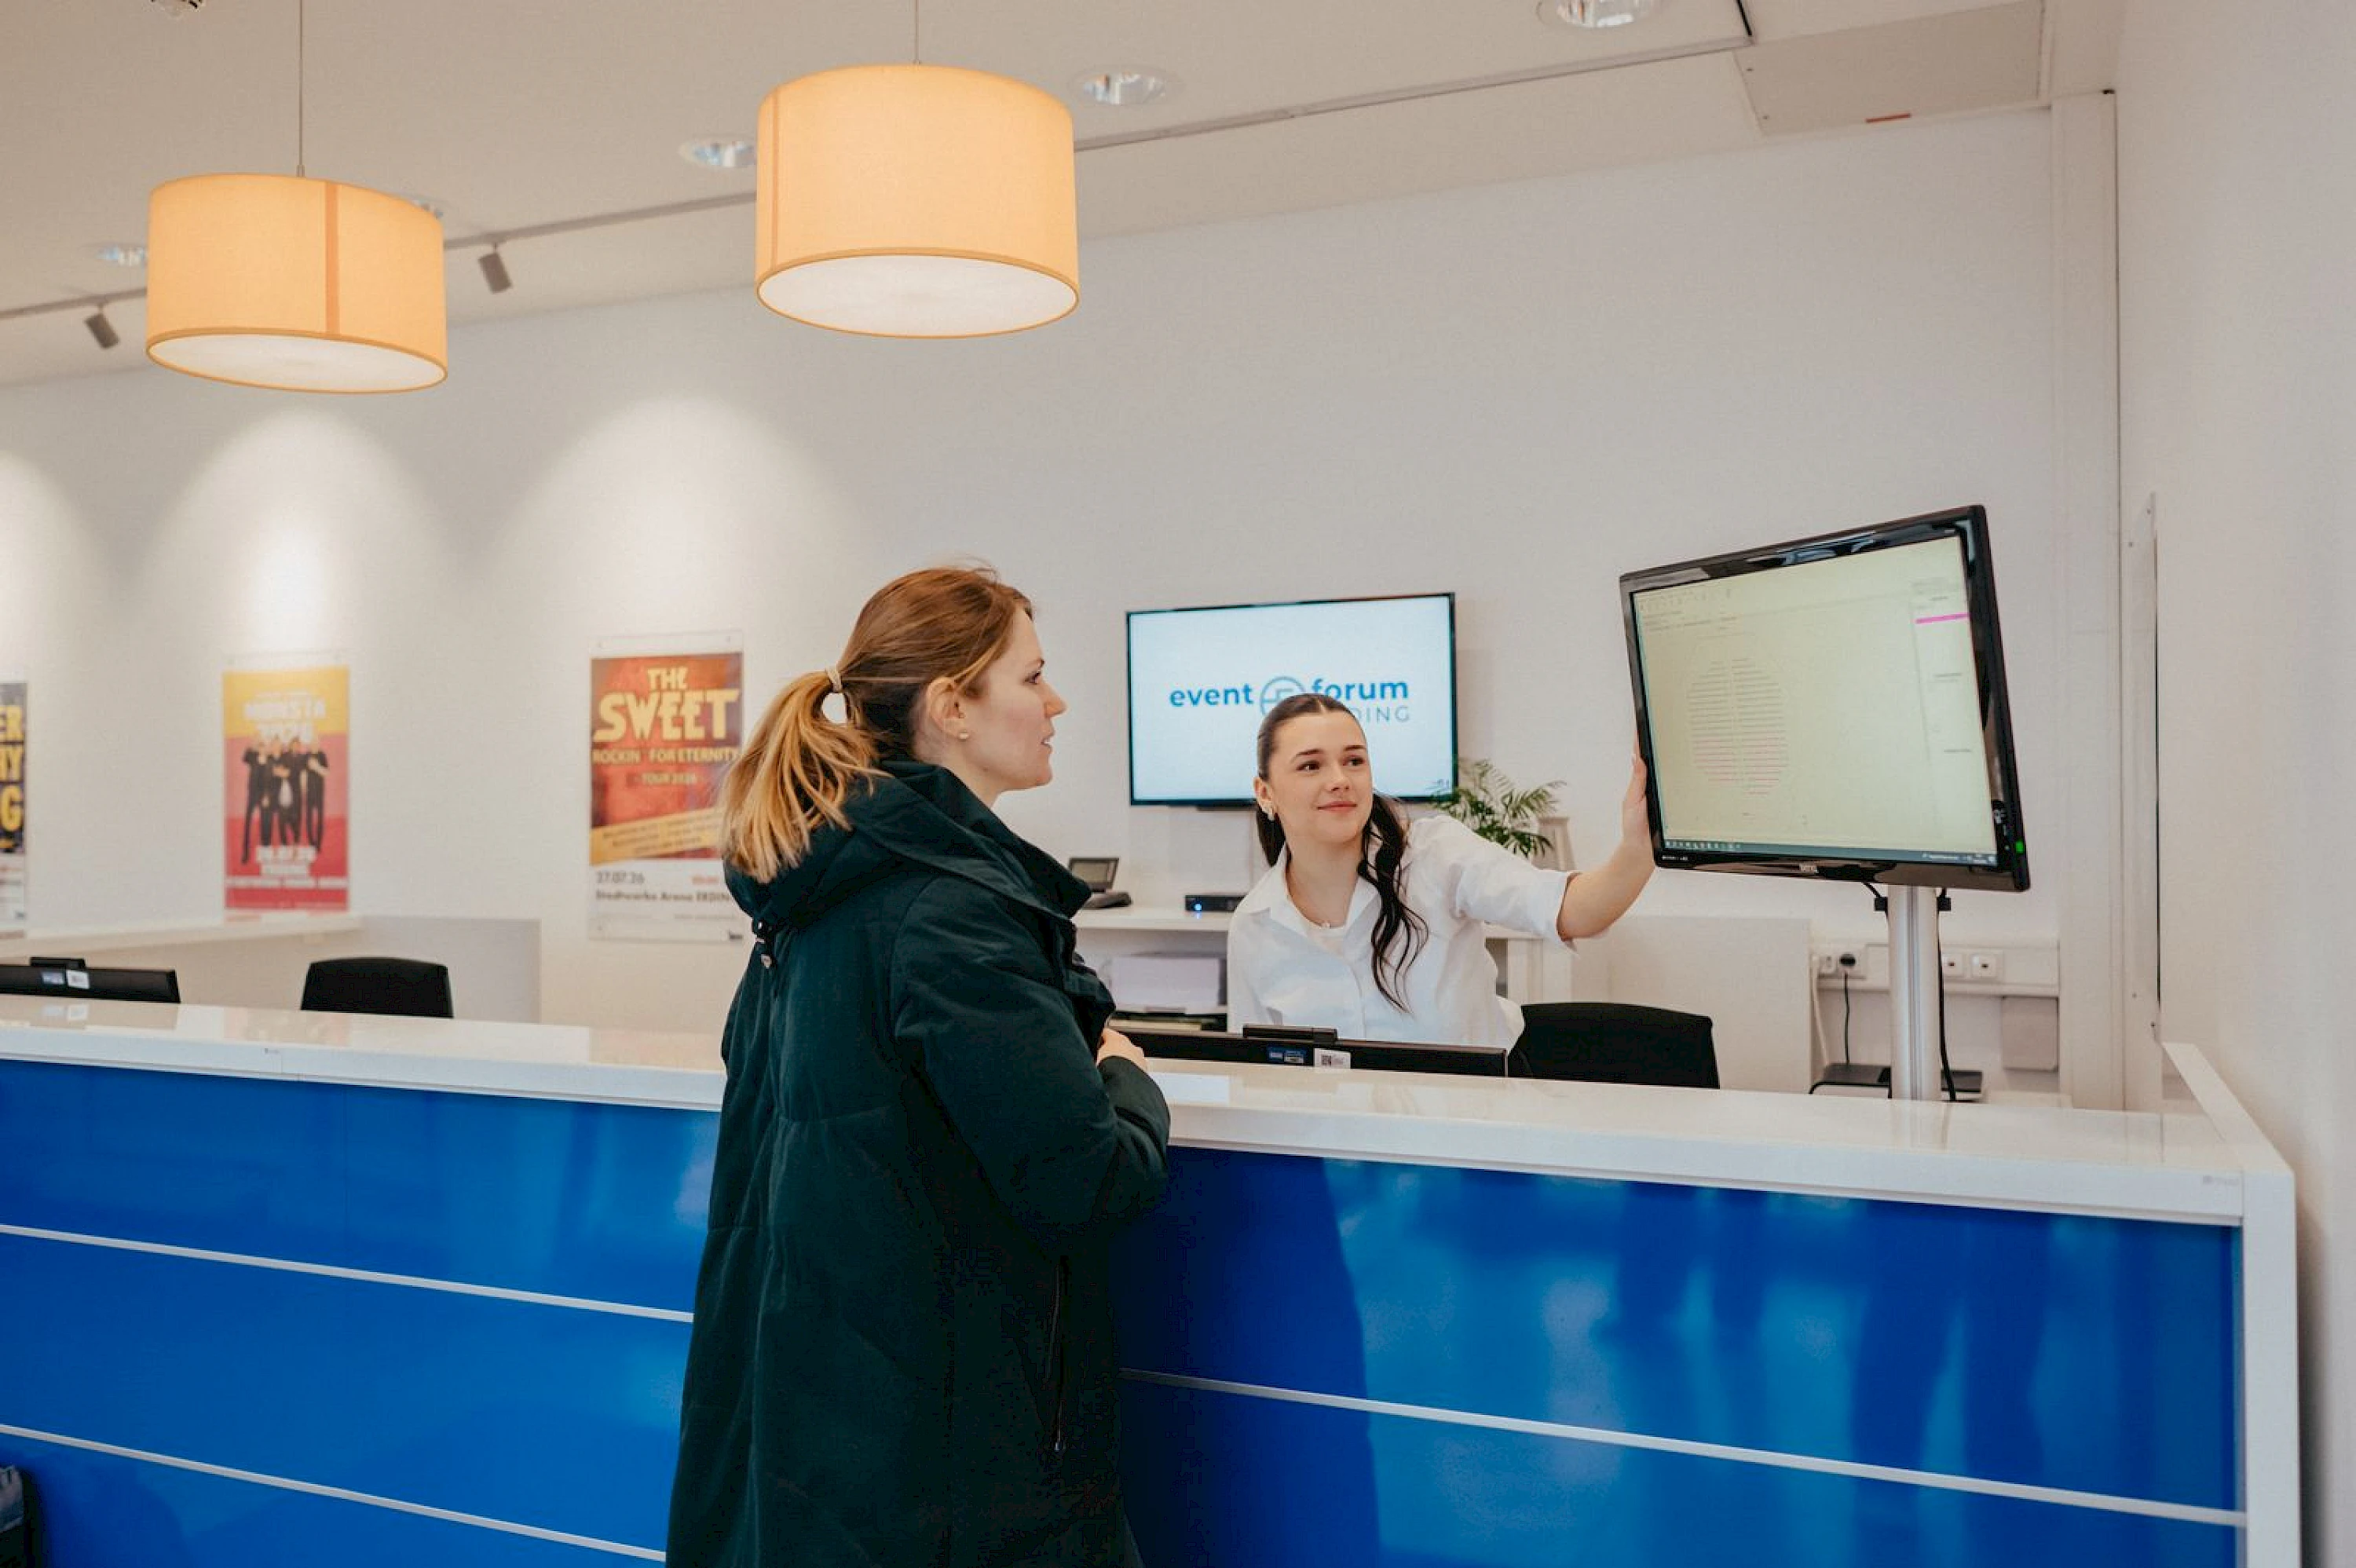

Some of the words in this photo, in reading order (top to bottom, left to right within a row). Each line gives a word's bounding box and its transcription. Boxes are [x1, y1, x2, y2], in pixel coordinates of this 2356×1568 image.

[647, 667, 689, 690] THE
[1169, 683, 1254, 706] event
[1312, 678, 1409, 700] forum
[594, 686, 740, 743] SWEET
